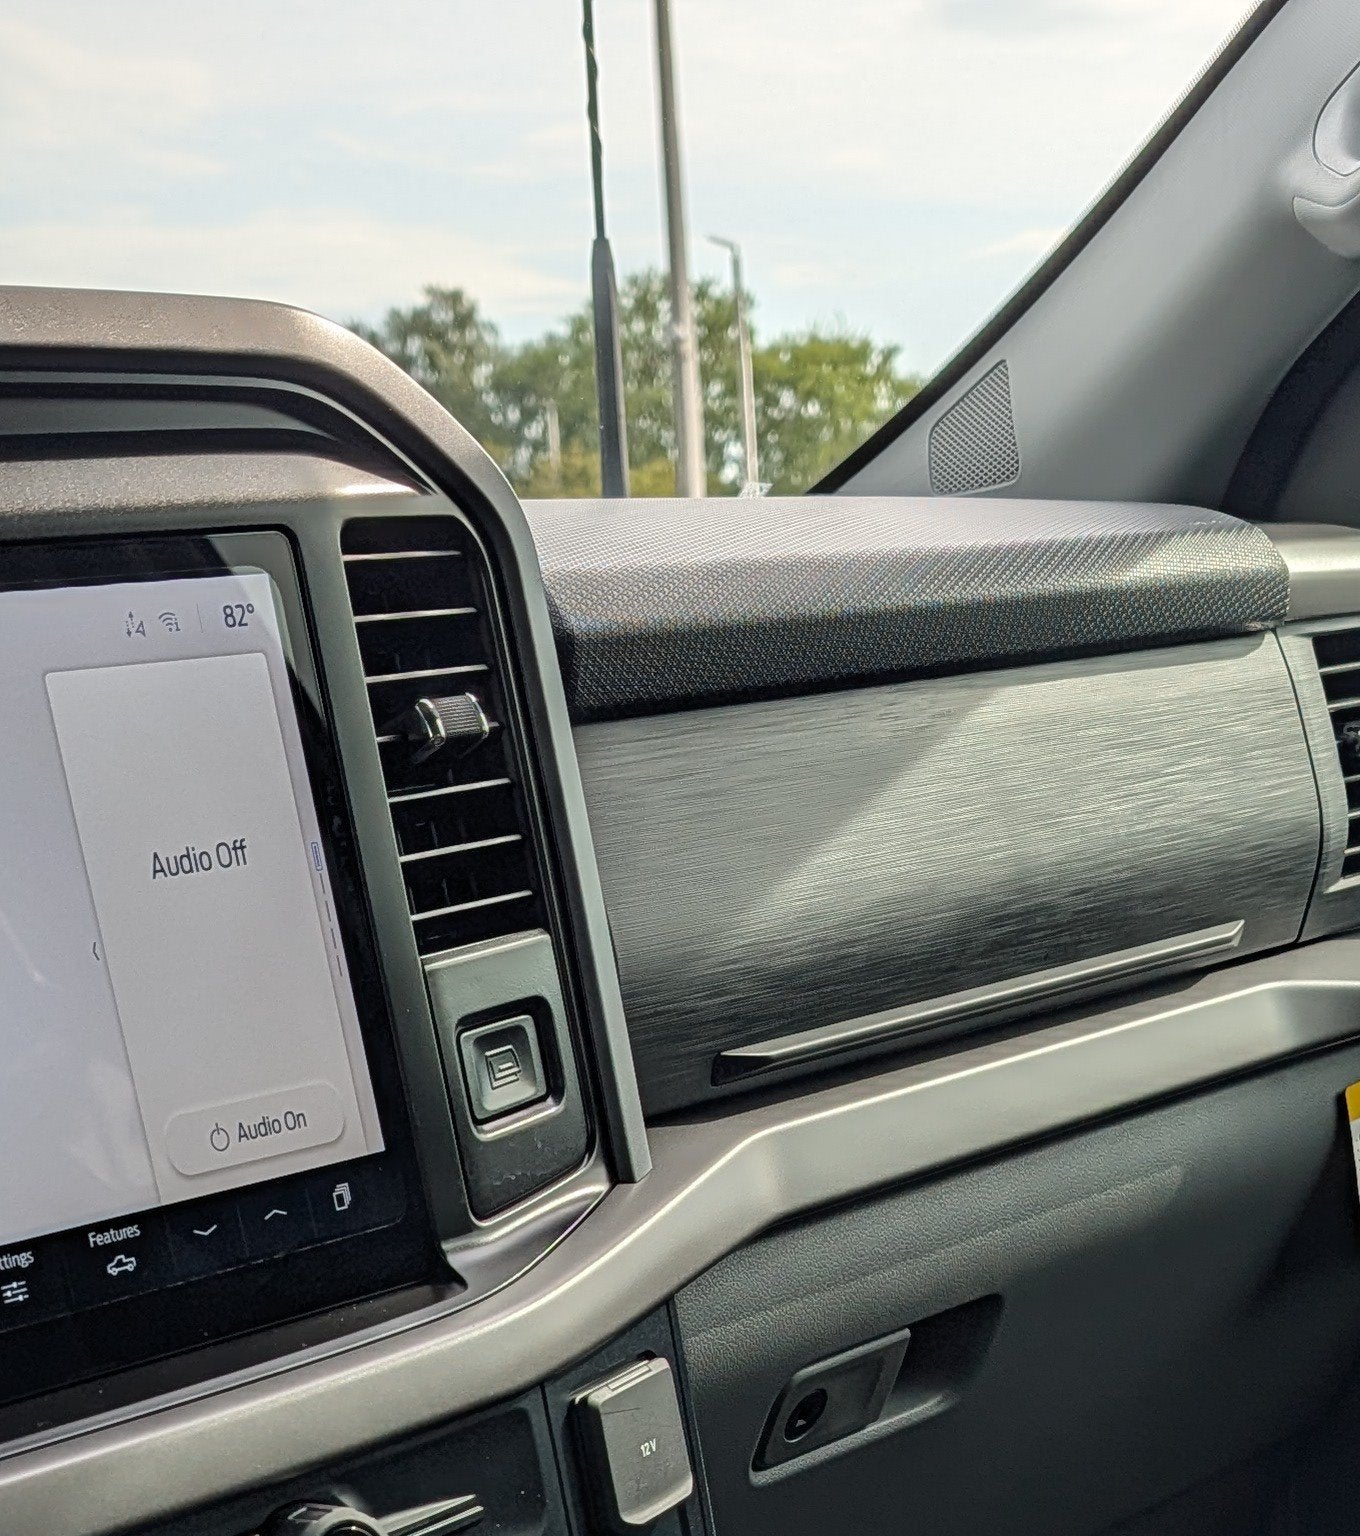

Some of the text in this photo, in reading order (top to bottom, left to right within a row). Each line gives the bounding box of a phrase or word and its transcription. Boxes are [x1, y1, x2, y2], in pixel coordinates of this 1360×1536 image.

[222, 603, 255, 628] 82°
[151, 838, 248, 880] Audio Off
[237, 1110, 308, 1142] Audio On
[88, 1223, 141, 1249] Features
[639, 1437, 657, 1458] 12V
